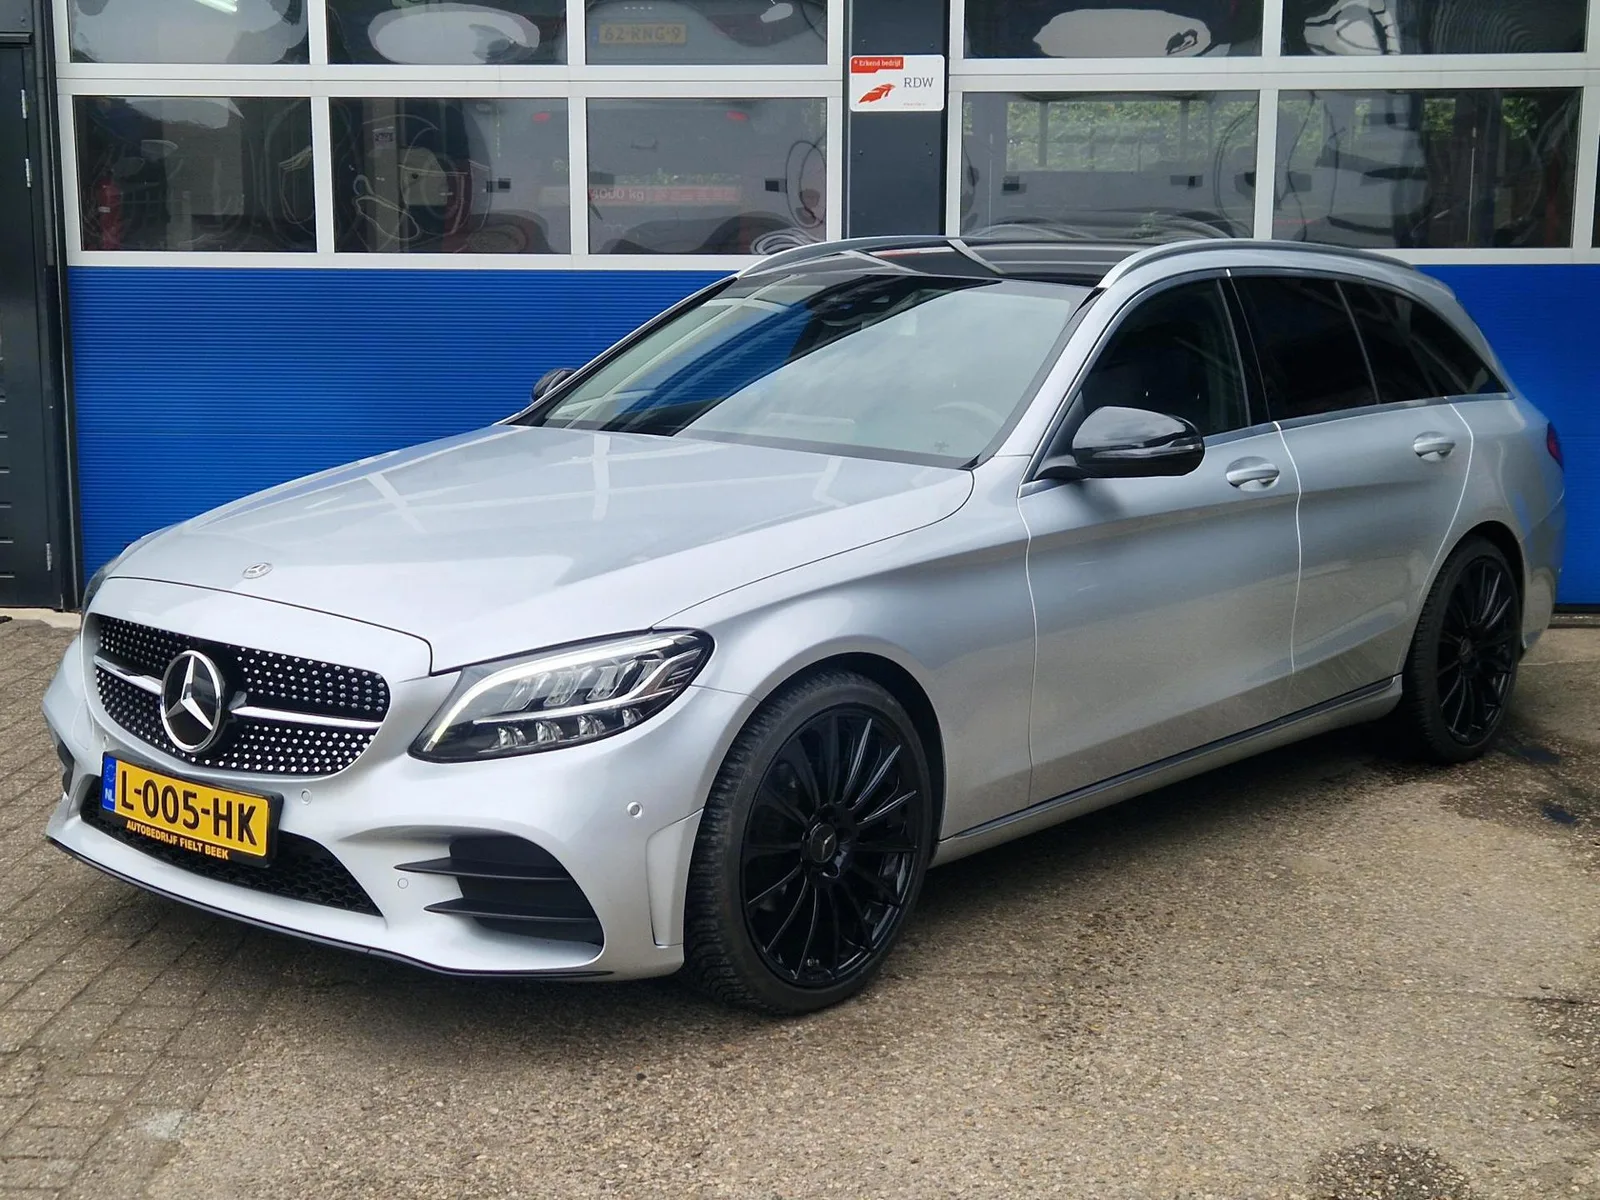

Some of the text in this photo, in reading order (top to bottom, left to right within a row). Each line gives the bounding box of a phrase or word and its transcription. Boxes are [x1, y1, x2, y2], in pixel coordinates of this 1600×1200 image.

[858, 59, 901, 68] Erkend bedrijf
[903, 77, 934, 88] RDW
[628, 188, 645, 202] kg
[104, 788, 115, 802] NL
[121, 770, 257, 846] L-005-HK
[126, 820, 230, 860] AUTOBEDRIJF FIELT BEEK
